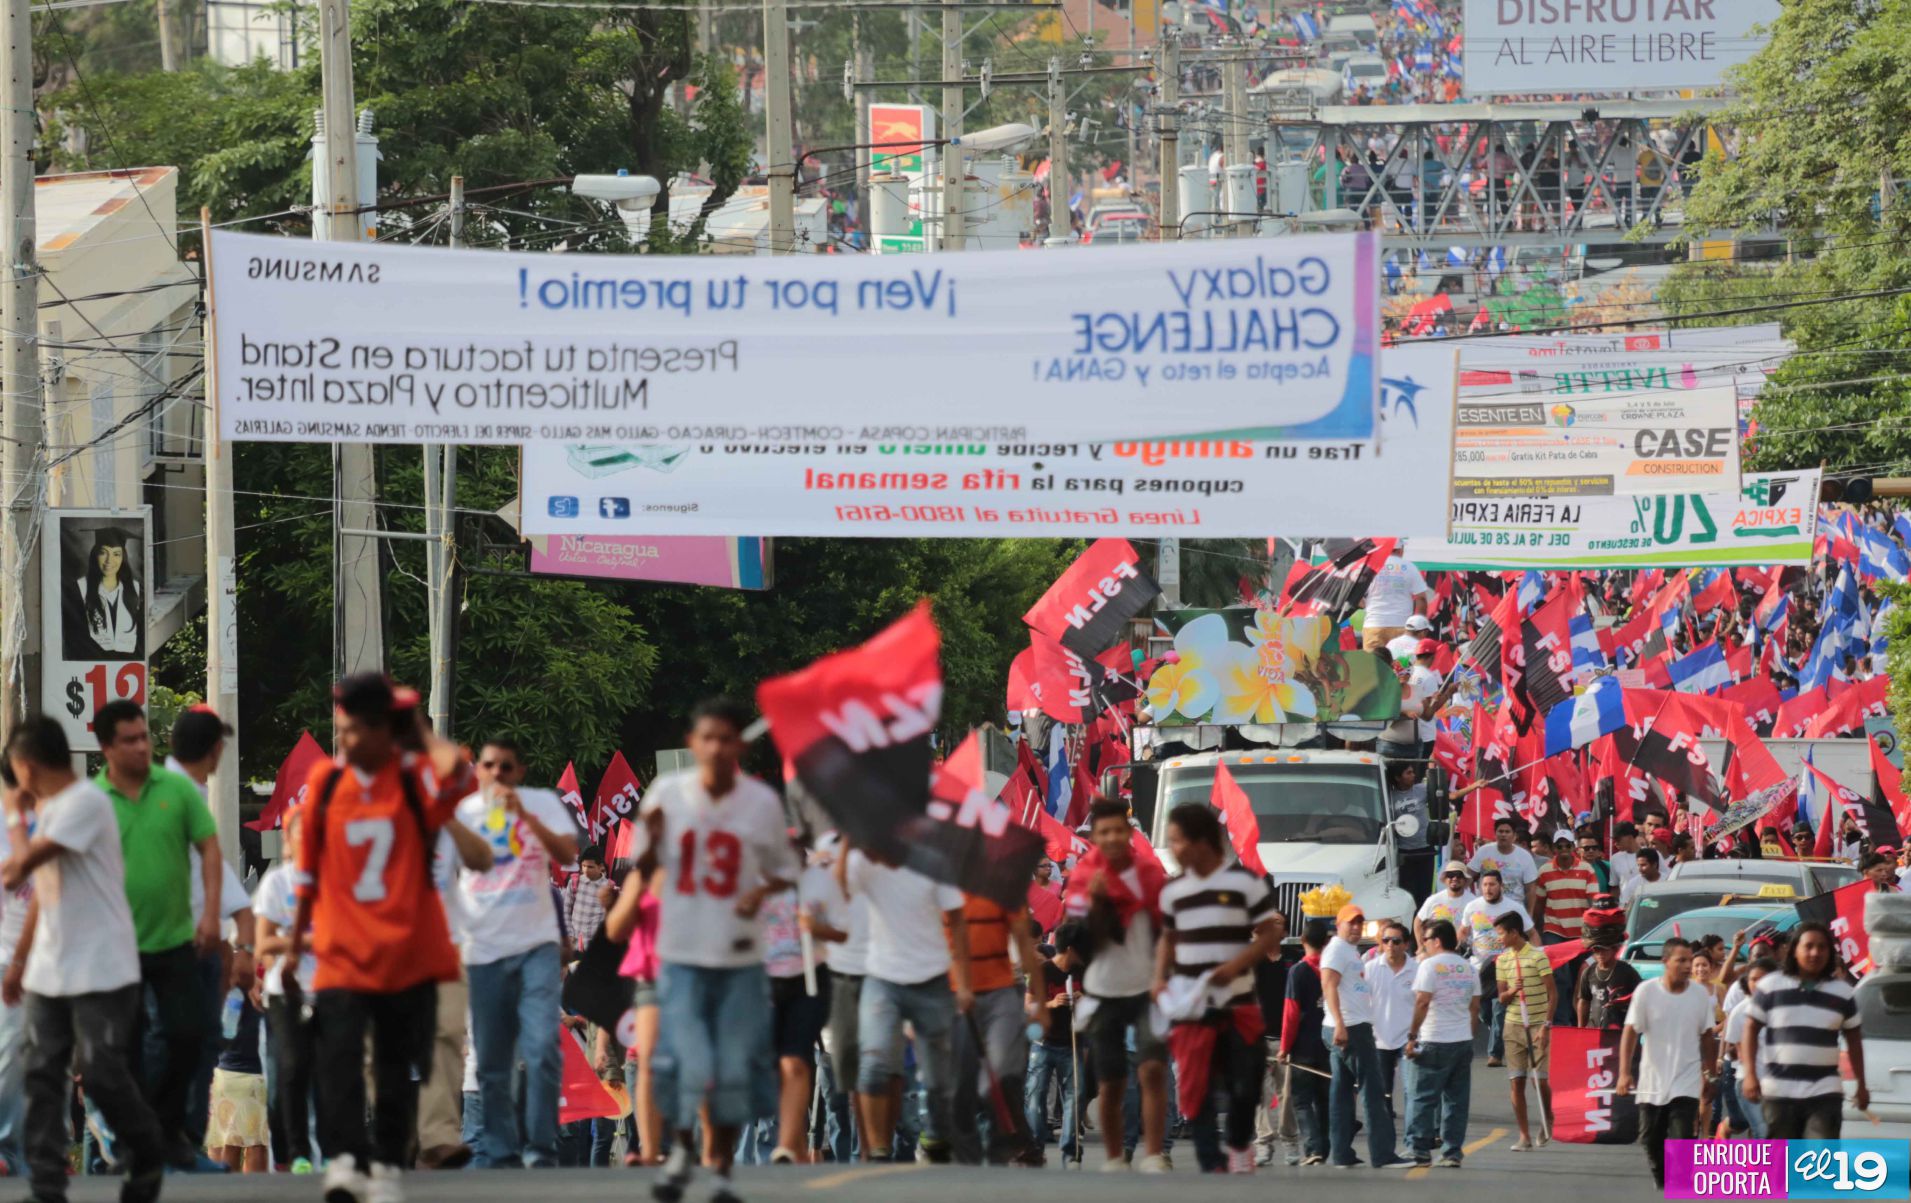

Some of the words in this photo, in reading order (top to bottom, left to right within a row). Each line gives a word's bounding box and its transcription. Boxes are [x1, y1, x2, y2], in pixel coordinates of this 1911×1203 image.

[1494, 36, 1533, 65] AL
[1545, 33, 1616, 64] AIRE
[1632, 31, 1716, 63] LIBRE
[1519, 406, 1543, 422] EN
[1656, 411, 1685, 419] PLAZA
[1634, 427, 1732, 458] CASE
[1511, 452, 1533, 462] Gratis
[1535, 450, 1547, 461] Kit
[1548, 450, 1566, 460] Pata
[1568, 450, 1577, 460] de
[1579, 450, 1598, 460] Cabra
[1643, 463, 1719, 474] CONSTRUCTION
[560, 535, 659, 559] Nicaragua
[345, 816, 396, 902] 7
[675, 828, 743, 900] 13
[1763, 887, 1787, 895] TAXI
